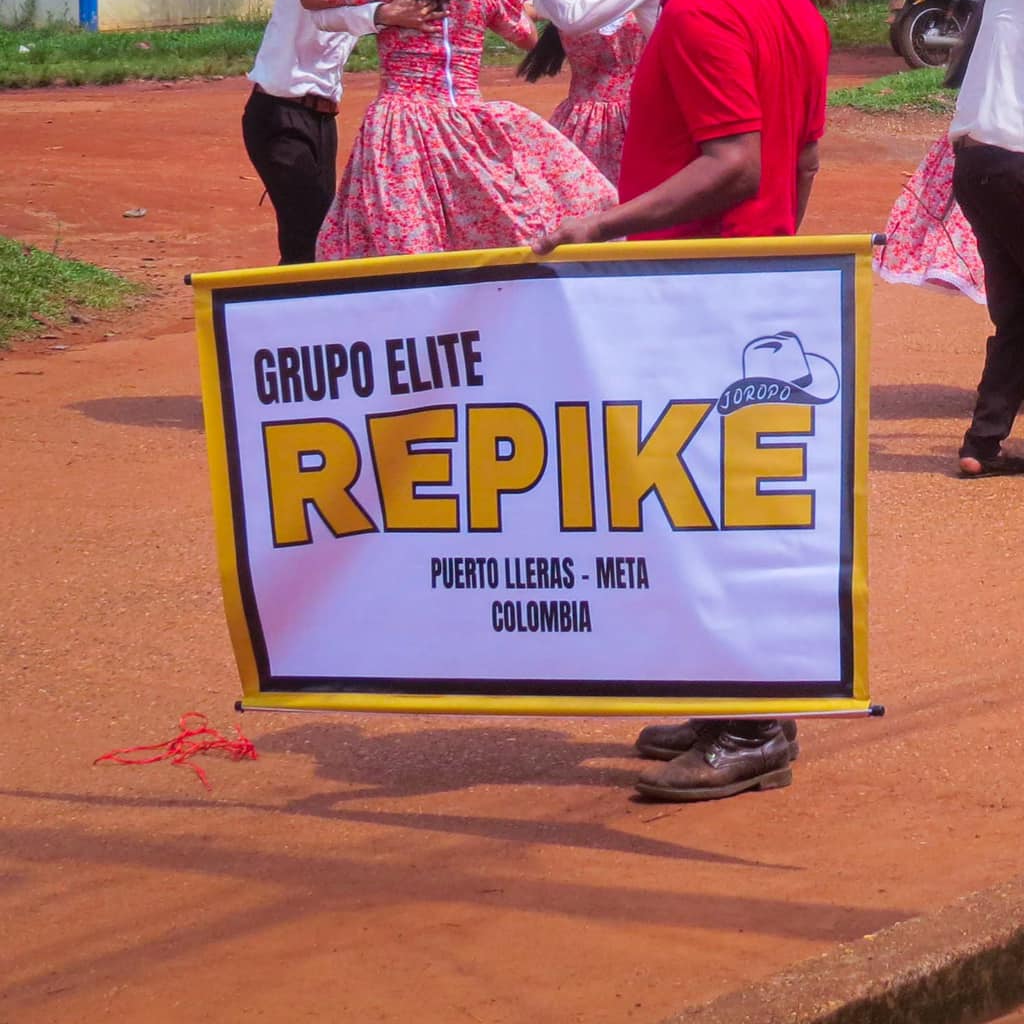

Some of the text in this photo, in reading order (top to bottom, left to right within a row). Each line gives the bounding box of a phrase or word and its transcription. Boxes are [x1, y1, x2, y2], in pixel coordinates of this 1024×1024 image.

[254, 331, 484, 404] GRUPO ELITE
[720, 383, 792, 410] JOROPO
[262, 399, 816, 549] REPIKE
[431, 557, 499, 589] PUERTO
[506, 557, 575, 589] LLERAS
[597, 557, 649, 589] META
[491, 599, 592, 632] COLOMBIA
